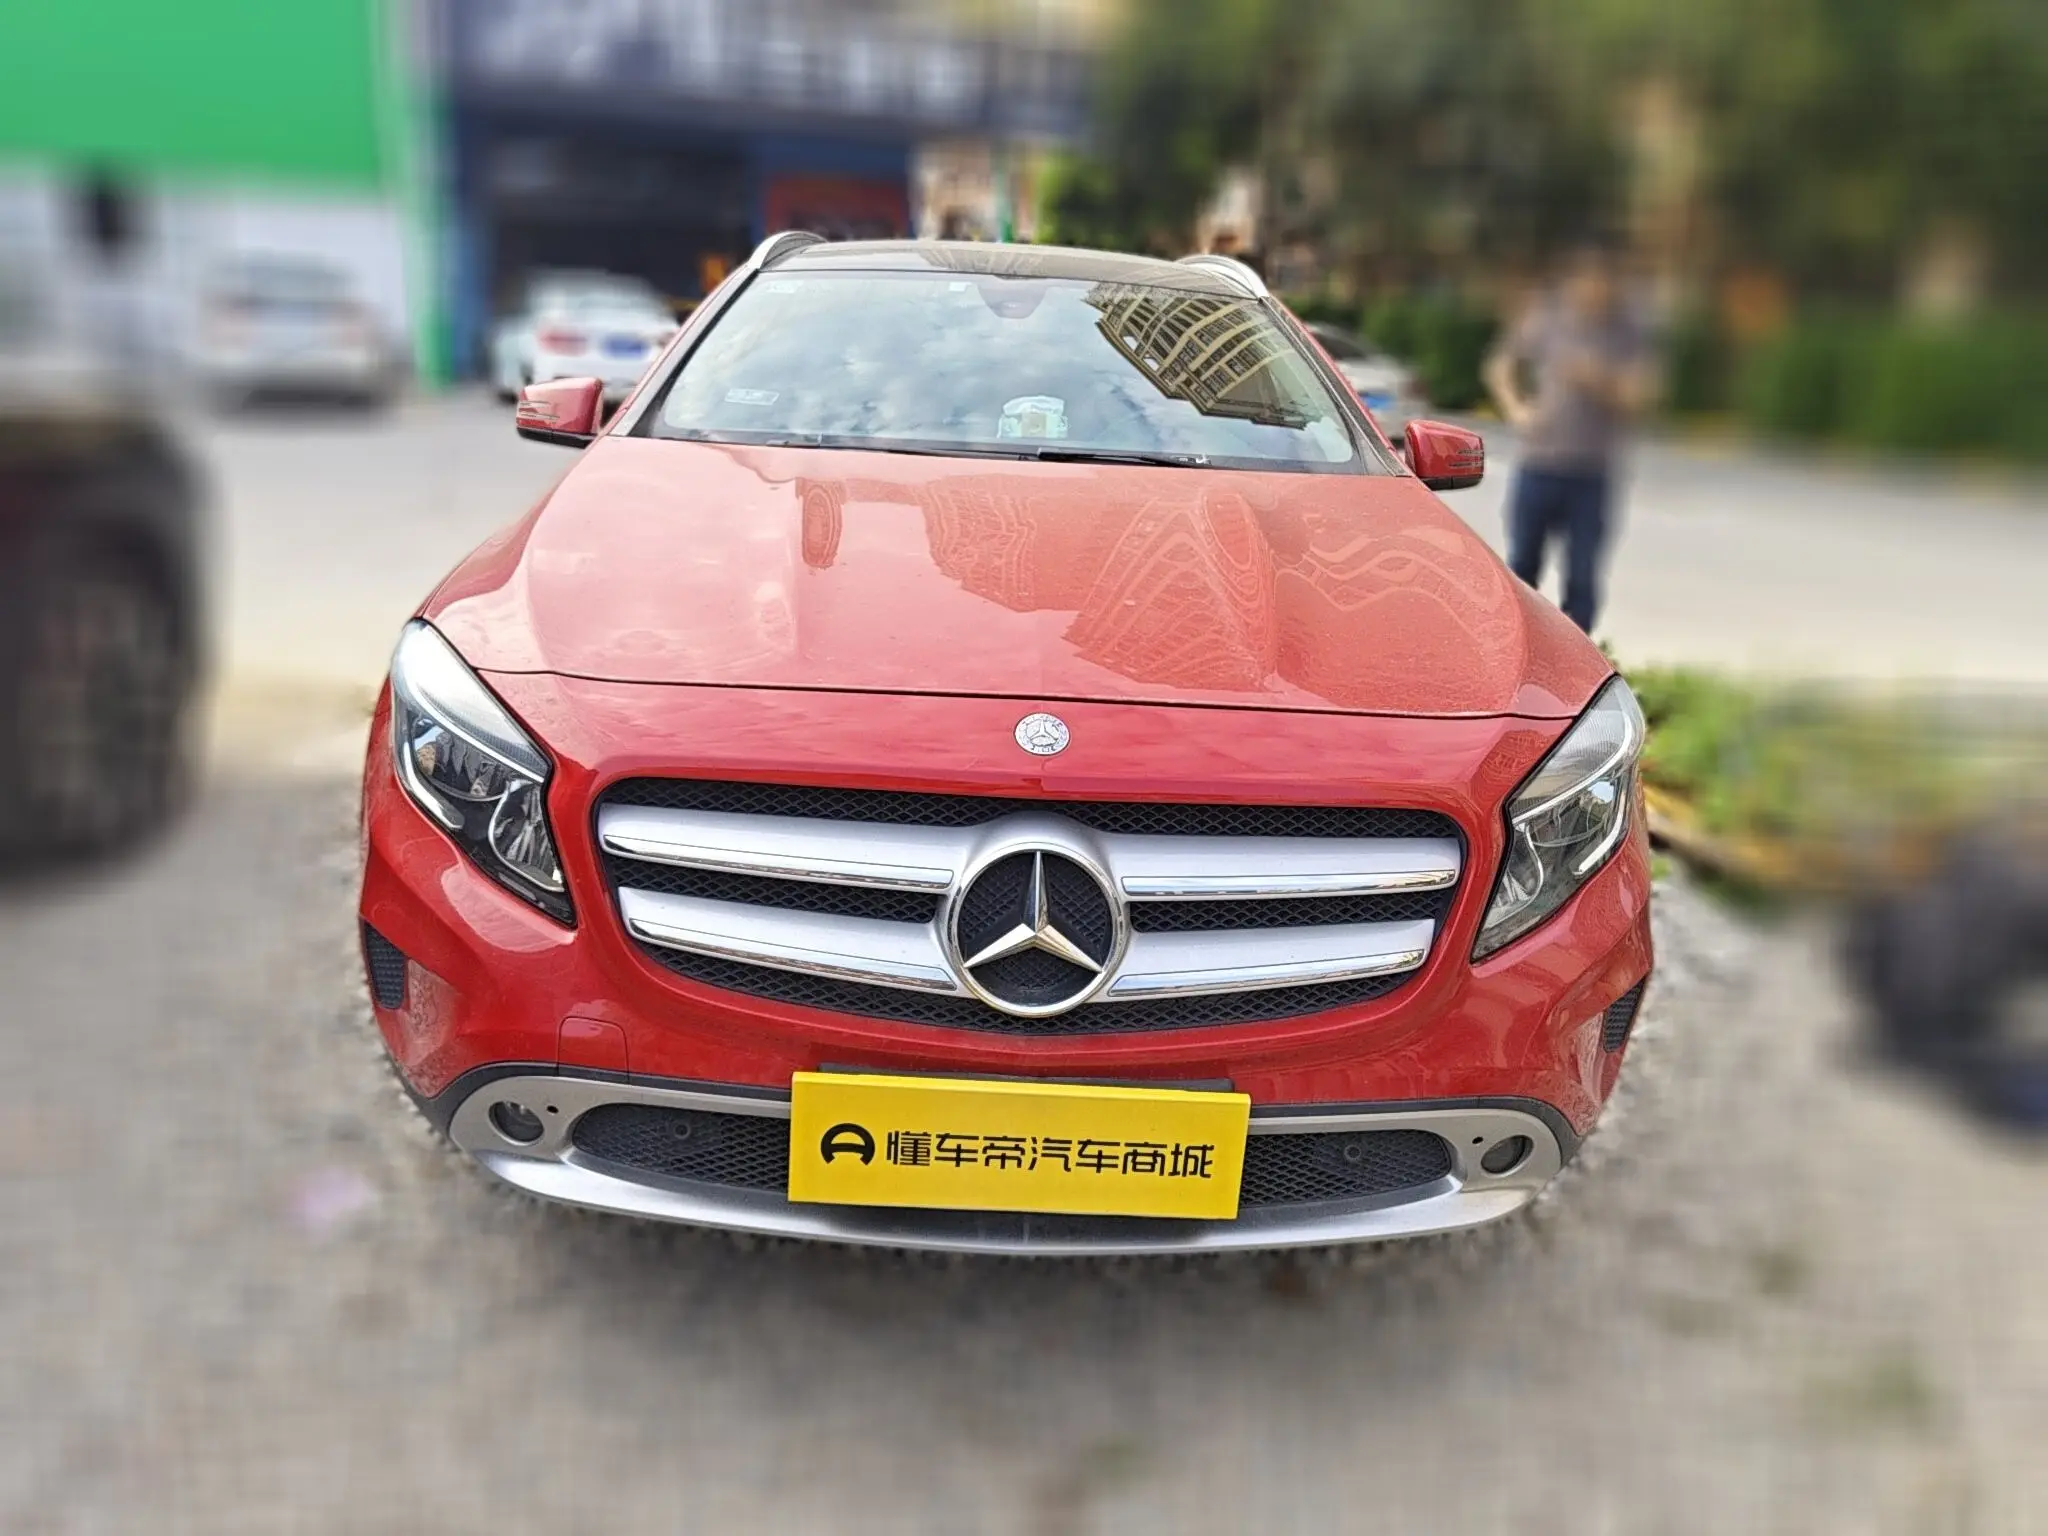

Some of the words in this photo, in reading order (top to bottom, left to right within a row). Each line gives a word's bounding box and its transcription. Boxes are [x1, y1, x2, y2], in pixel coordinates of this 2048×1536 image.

[886, 1130, 1214, 1178] 懂车帝汽车商城
